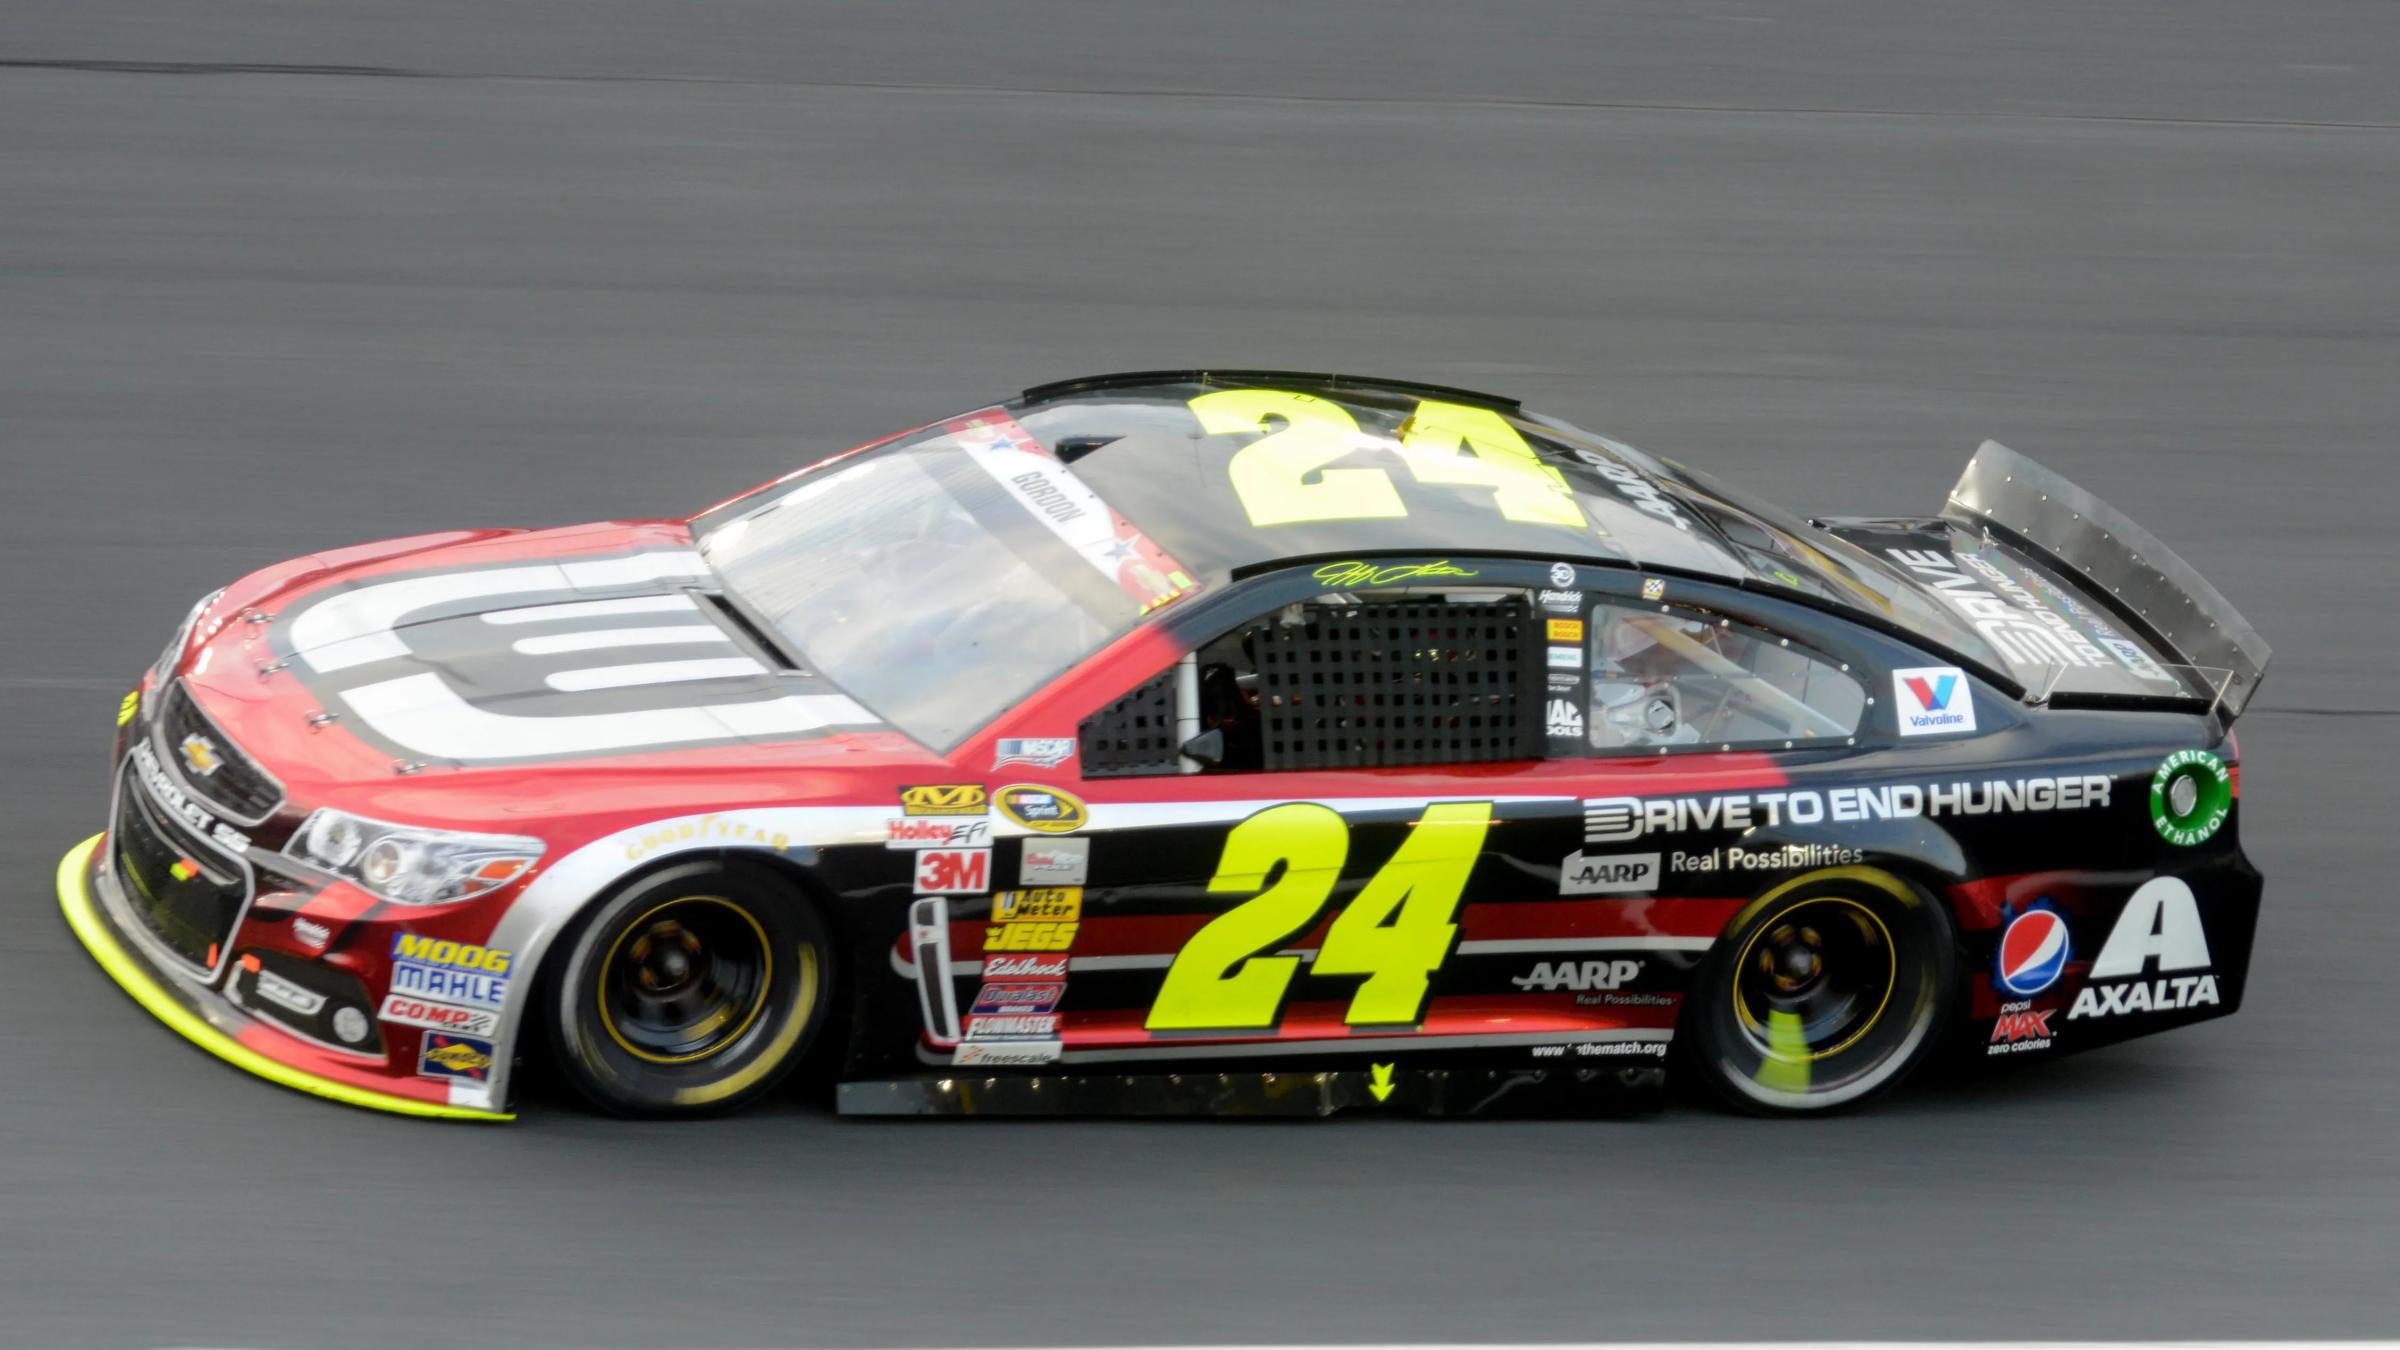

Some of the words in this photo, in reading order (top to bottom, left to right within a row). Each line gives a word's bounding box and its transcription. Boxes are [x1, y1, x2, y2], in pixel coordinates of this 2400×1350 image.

[1187, 389, 1588, 527] 24
[1011, 471, 1087, 522] GORDON
[1575, 449, 1692, 531] AARP
[1956, 552, 2050, 611] HUNGER
[1886, 548, 2080, 667] DRIVE
[2033, 610, 2090, 646] END
[1910, 713, 1964, 727] Valvoline
[2151, 749, 2228, 795] AMERICAN
[1024, 805, 1058, 818] Sprint
[1584, 795, 1752, 843] DRIVE
[1757, 791, 1821, 826] TO
[1829, 785, 1923, 822] END
[1930, 774, 2112, 818] HUNGER
[626, 815, 789, 853] GOODYEAR
[889, 820, 953, 845] Holley
[2154, 806, 2228, 845] ETHANOL
[919, 852, 986, 890] 3M
[1671, 847, 1720, 871] Real
[1728, 845, 1864, 871] Possibilities
[1570, 862, 1650, 885] AARP
[1017, 903, 1074, 916] Meter
[1021, 889, 1067, 903] Auto
[1144, 801, 1494, 1030] 24
[983, 923, 1079, 950] JEGS
[394, 934, 513, 973] MOOG
[983, 957, 1068, 977] Edelbrock
[396, 964, 505, 1003] MAHLE
[1512, 960, 1641, 990] AARP
[388, 999, 470, 1024] COMP
[1576, 994, 1602, 1005] Real
[1604, 993, 1673, 1006] Possibilities
[2001, 999, 2031, 1014] pepsi
[2067, 974, 2220, 1020] AXALTA
[971, 1016, 1057, 1034] FLOWMASTER
[1991, 1009, 2057, 1042] MAX
[980, 1053, 1052, 1064] freescale
[1532, 1042, 1667, 1057] wwwthematch.org
[1987, 1044, 2010, 1055] zero
[2011, 1038, 2051, 1052] calories
